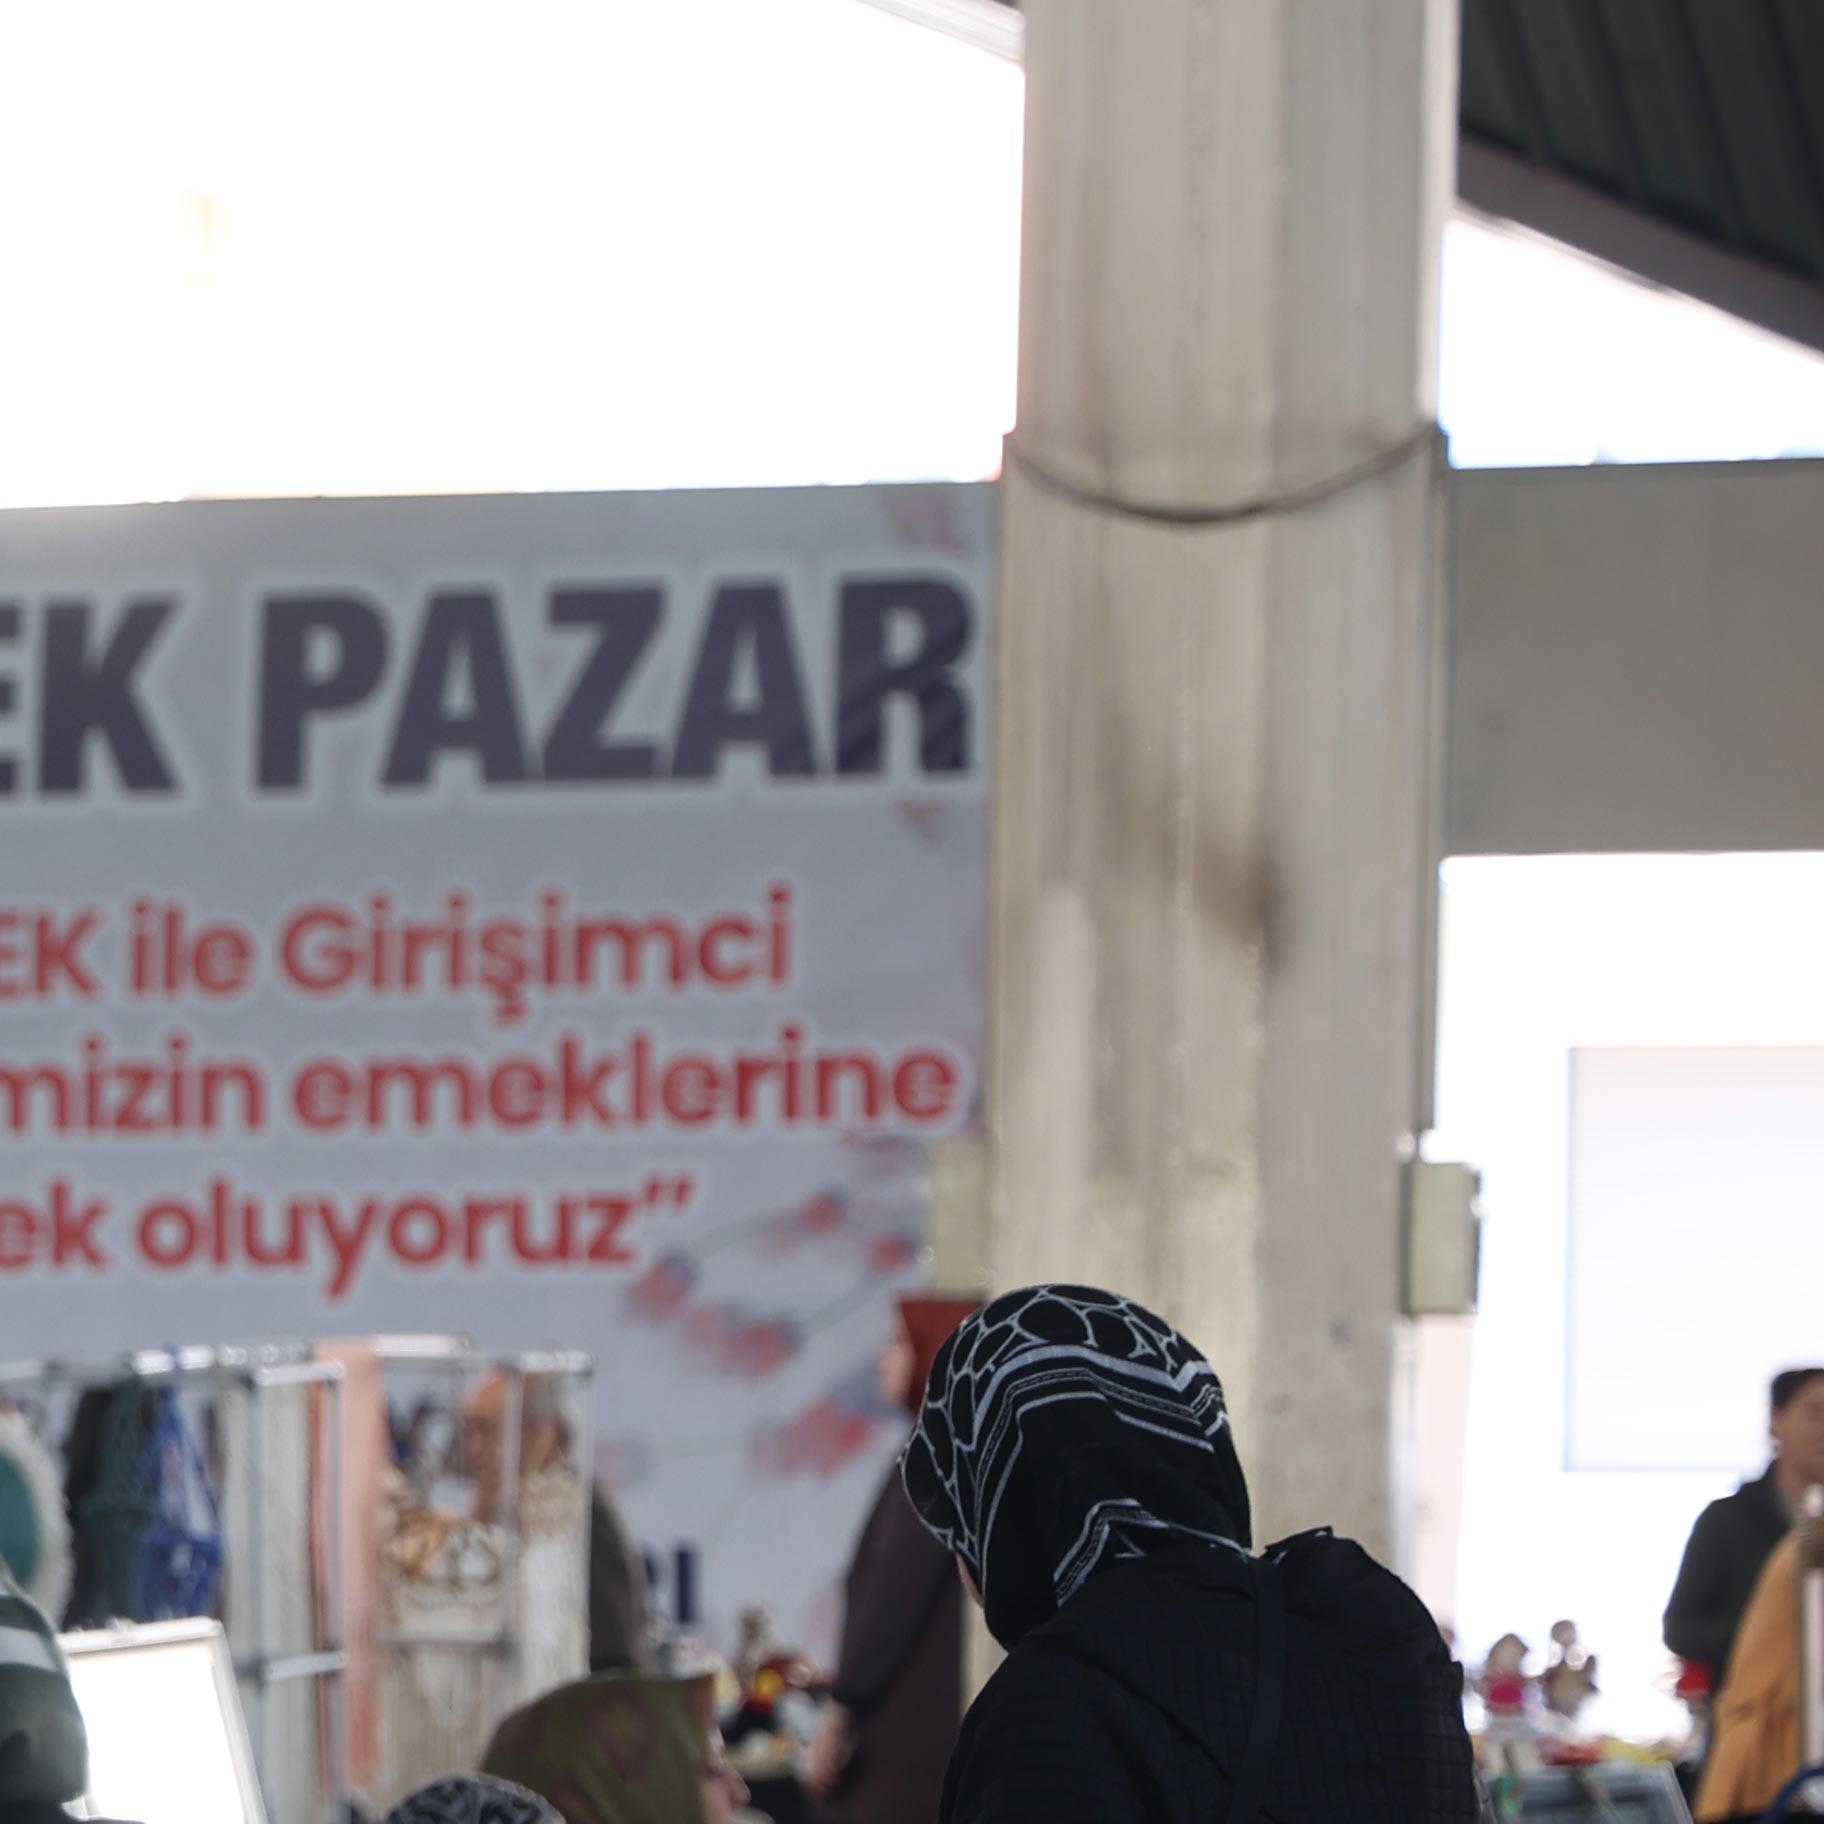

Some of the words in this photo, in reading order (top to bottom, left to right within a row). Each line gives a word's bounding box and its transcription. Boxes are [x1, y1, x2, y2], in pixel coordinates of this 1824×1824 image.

[257, 578, 972, 788] PAZAR
[132, 902, 250, 994] ile
[280, 888, 789, 1020] Girişimci
[290, 1026, 958, 1128] emeklerine
